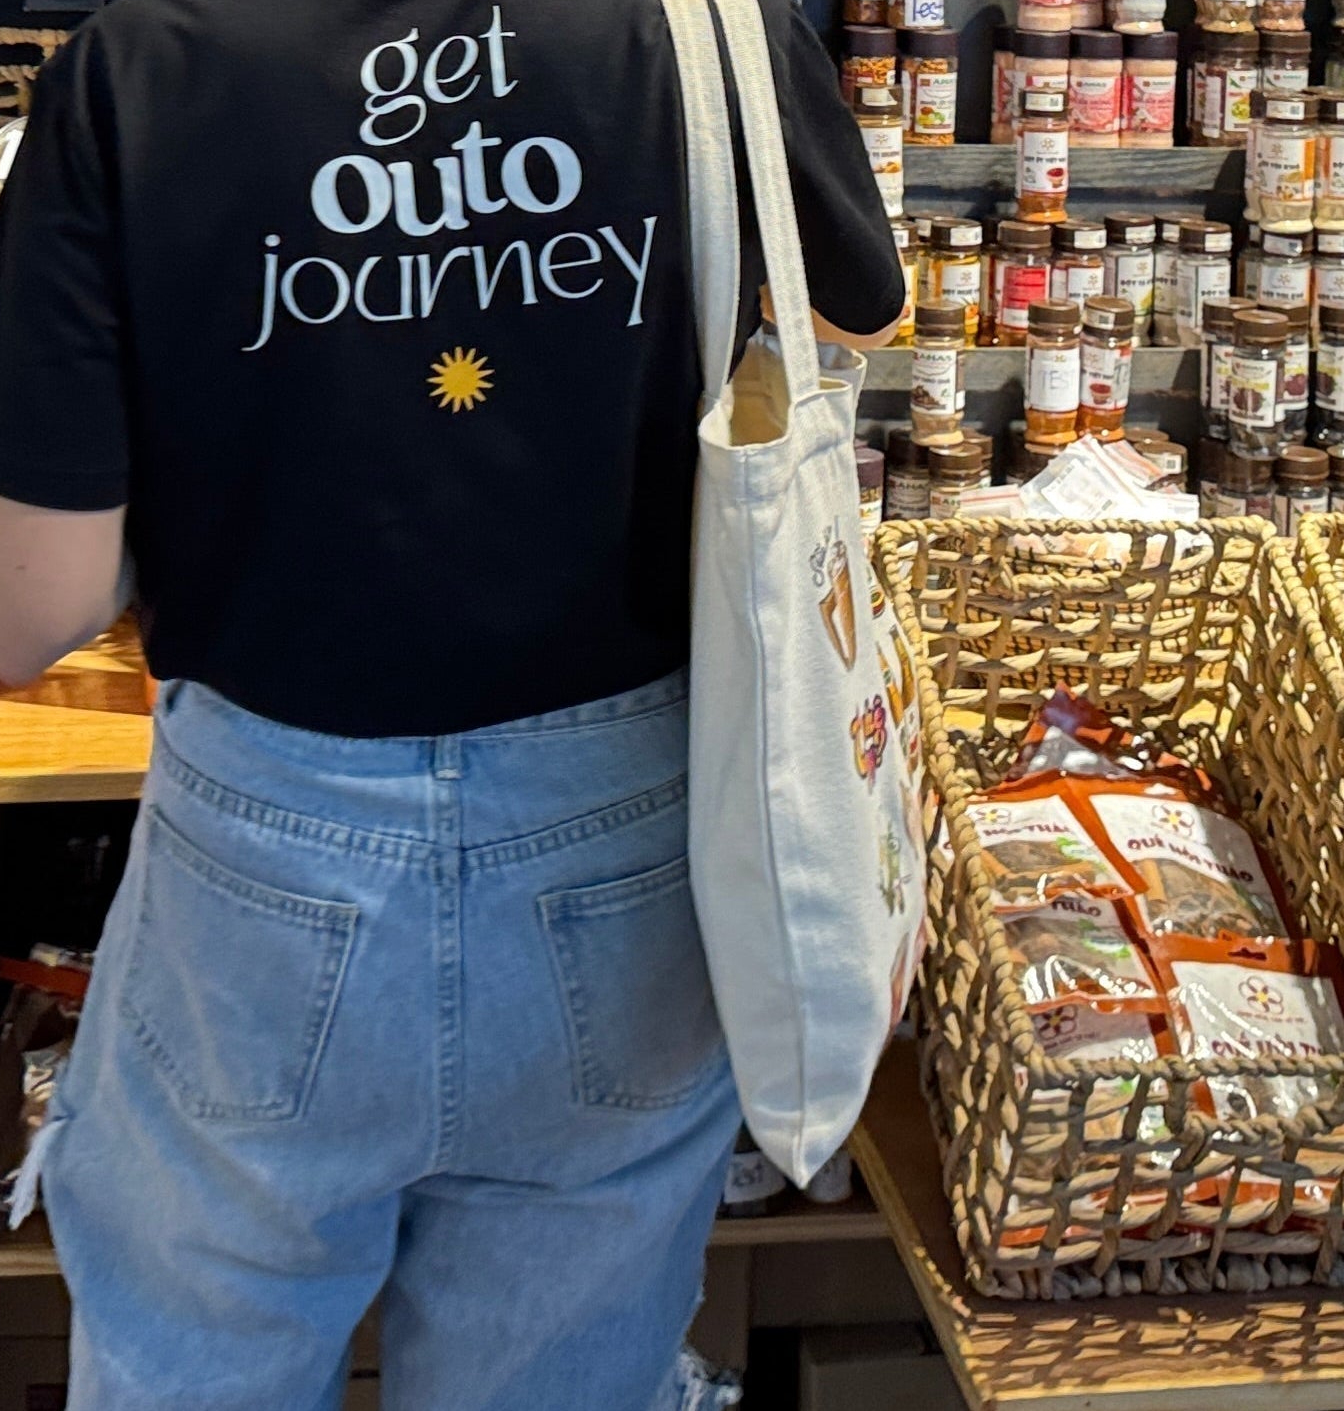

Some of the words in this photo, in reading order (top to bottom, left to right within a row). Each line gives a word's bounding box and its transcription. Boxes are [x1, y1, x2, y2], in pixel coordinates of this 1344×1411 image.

[359, 5, 519, 147] get
[311, 120, 583, 237] outo
[241, 216, 657, 351] journey
